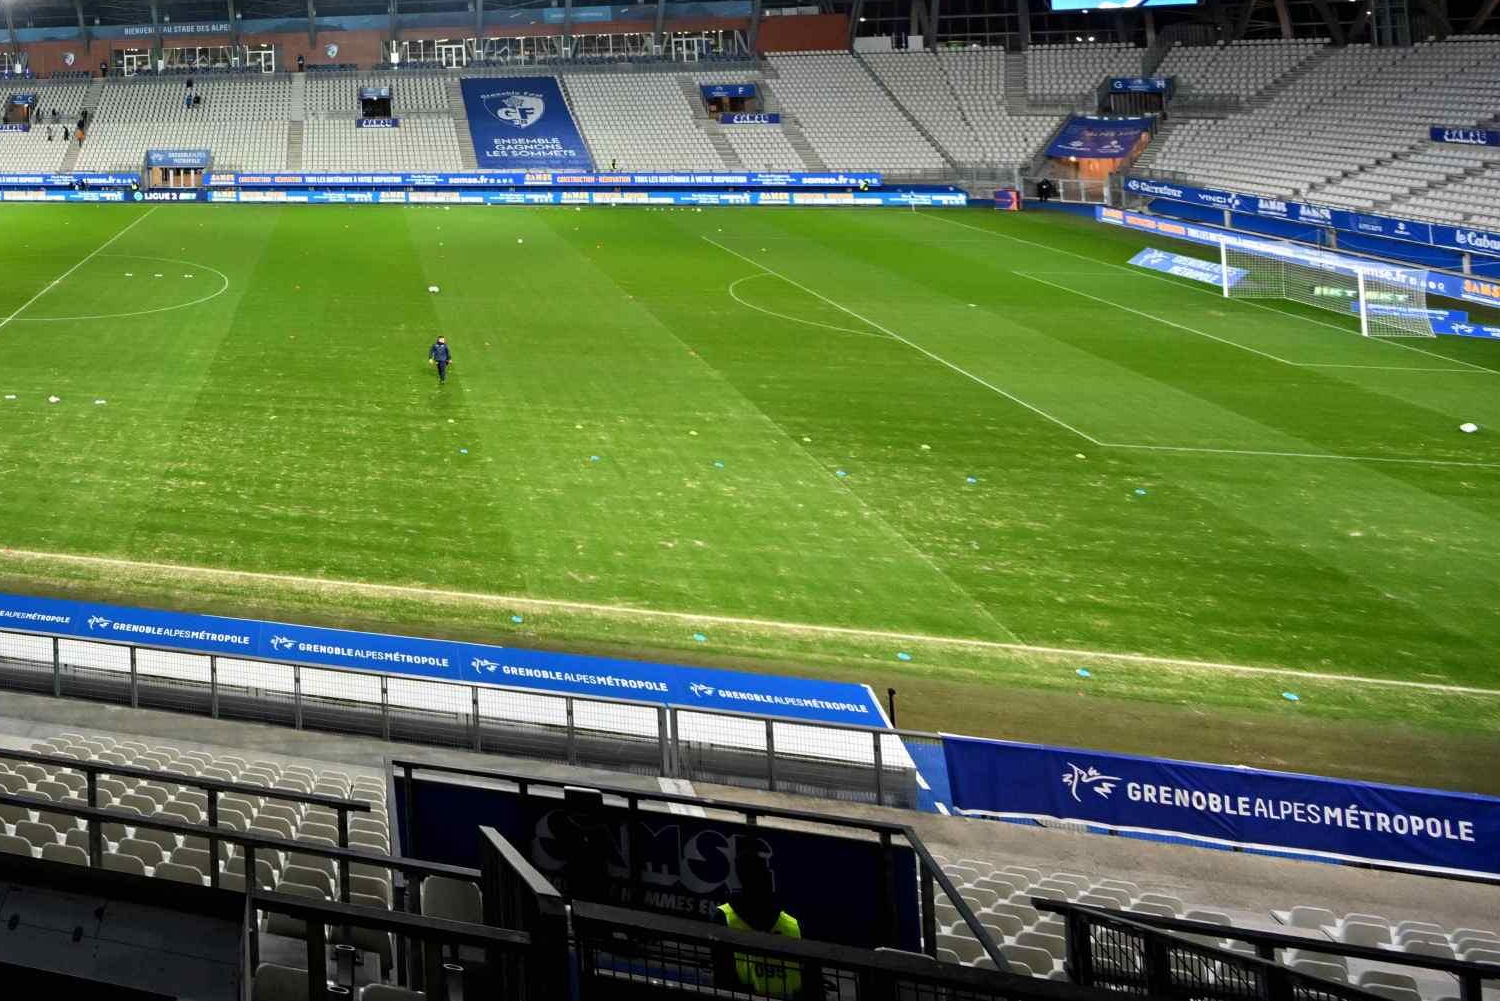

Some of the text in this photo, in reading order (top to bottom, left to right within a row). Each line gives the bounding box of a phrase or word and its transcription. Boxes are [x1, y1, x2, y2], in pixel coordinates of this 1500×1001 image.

[125, 26, 161, 36] BIENVEN
[174, 26, 196, 34] STADE
[197, 25, 210, 33] DES
[1139, 180, 1184, 198] Carrefour
[144, 192, 170, 201] LIGUE
[171, 192, 179, 201] 2
[620, 887, 694, 912] HMMES
